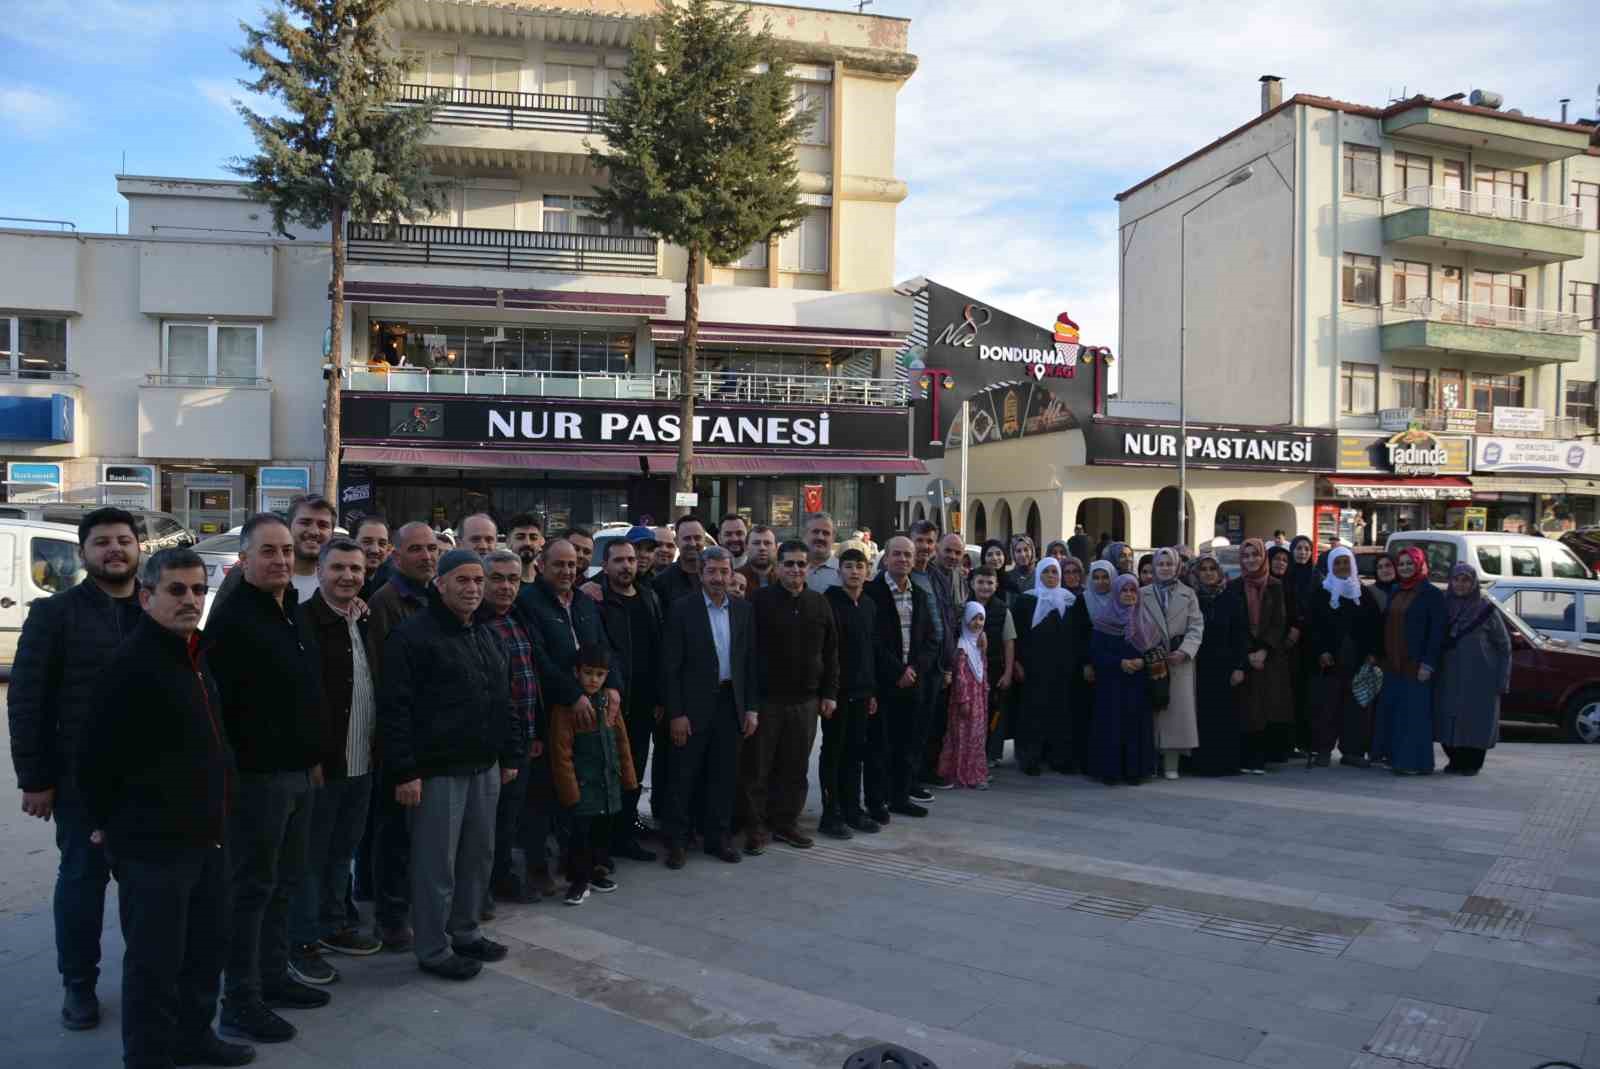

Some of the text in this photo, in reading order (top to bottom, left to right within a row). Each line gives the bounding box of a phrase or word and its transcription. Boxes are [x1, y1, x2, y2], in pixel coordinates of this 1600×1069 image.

[980, 344, 1065, 365] DONDURMA
[488, 409, 583, 440] NUR
[1125, 433, 1312, 462] NUR PASTANESİ
